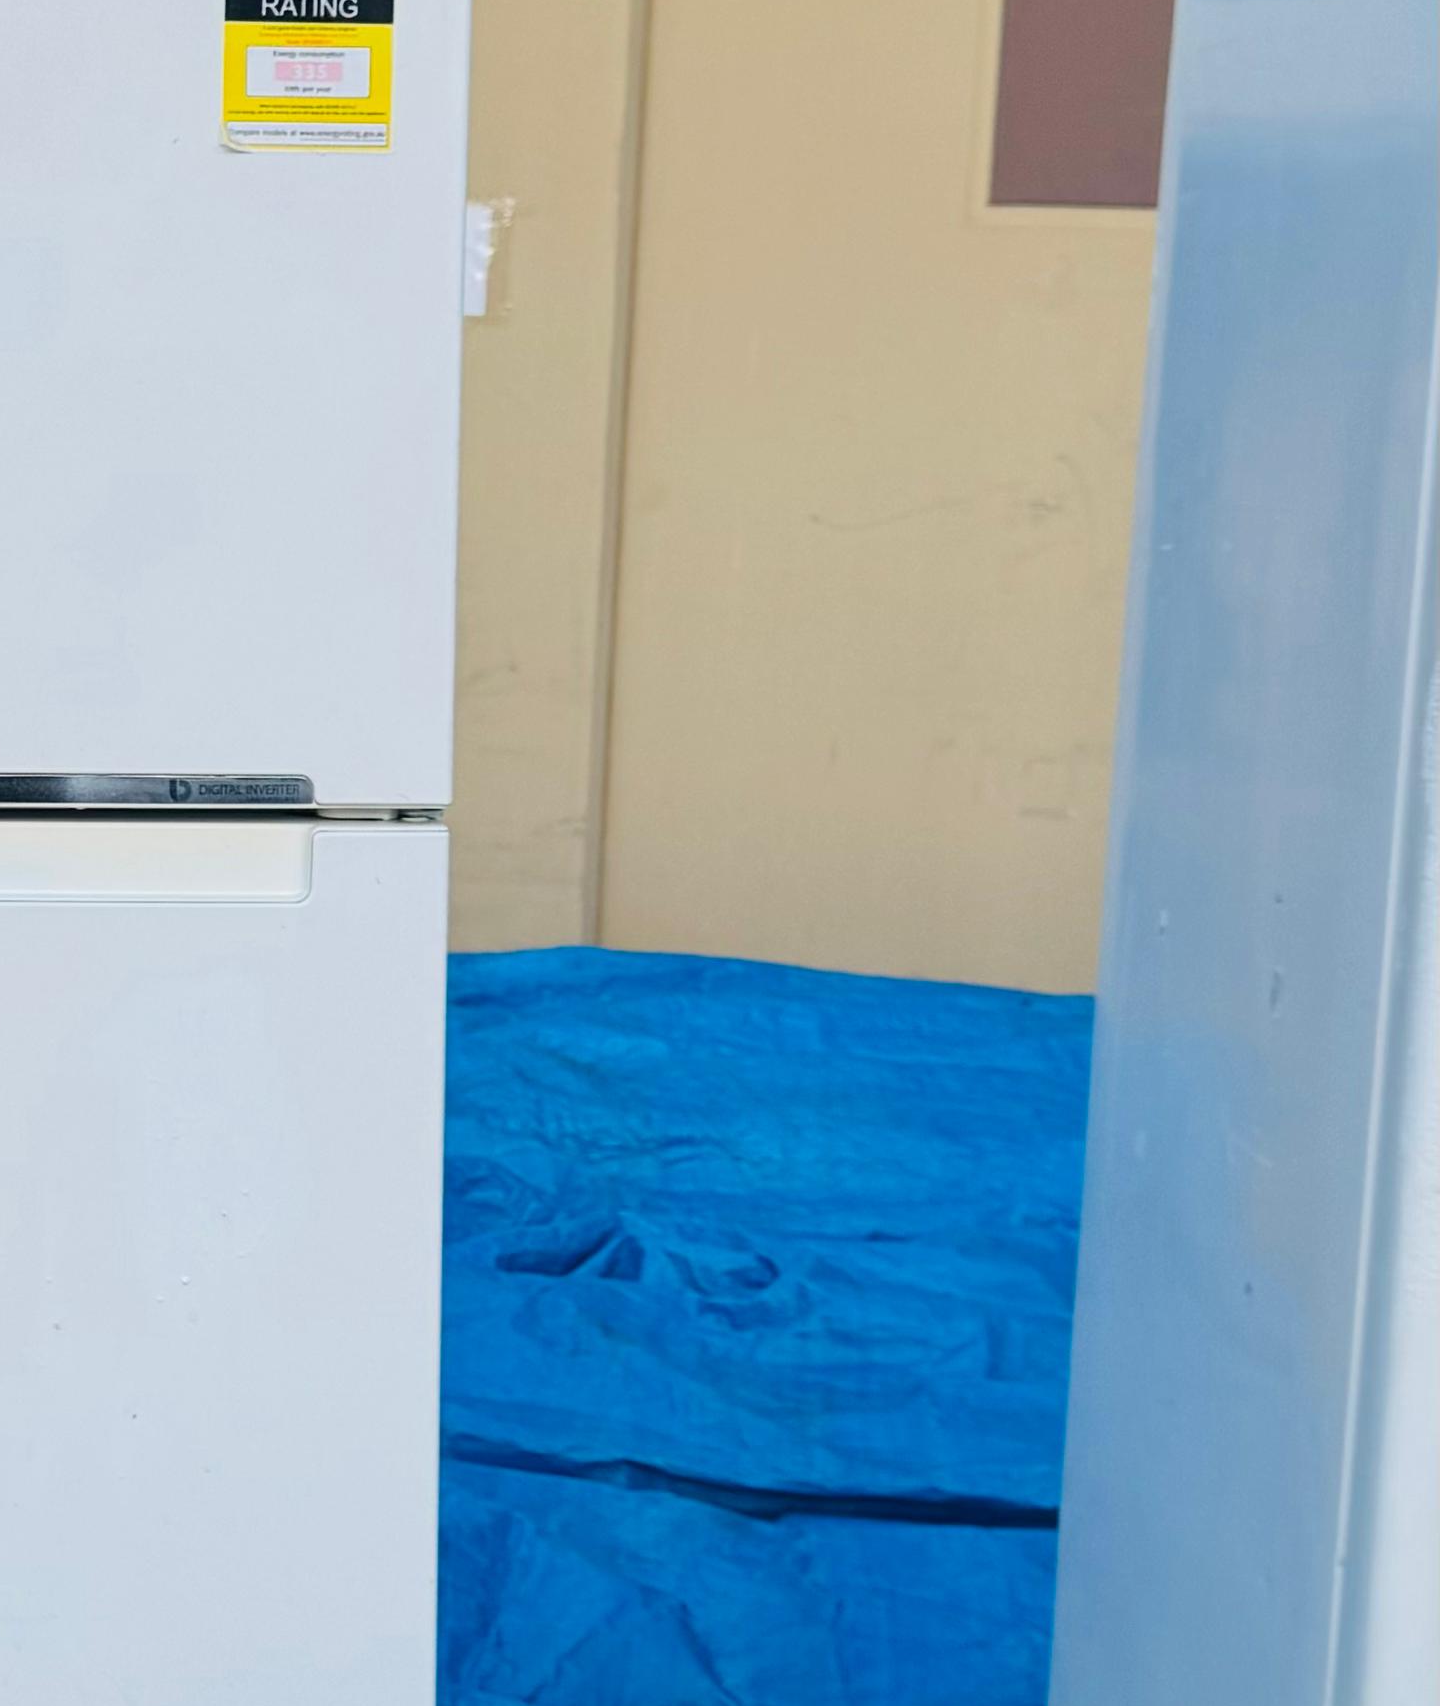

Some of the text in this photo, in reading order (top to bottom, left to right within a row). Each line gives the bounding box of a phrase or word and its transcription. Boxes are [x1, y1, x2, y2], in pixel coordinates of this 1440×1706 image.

[291, 64, 329, 79] 335
[199, 784, 300, 795] DIGITAL INVERTER
